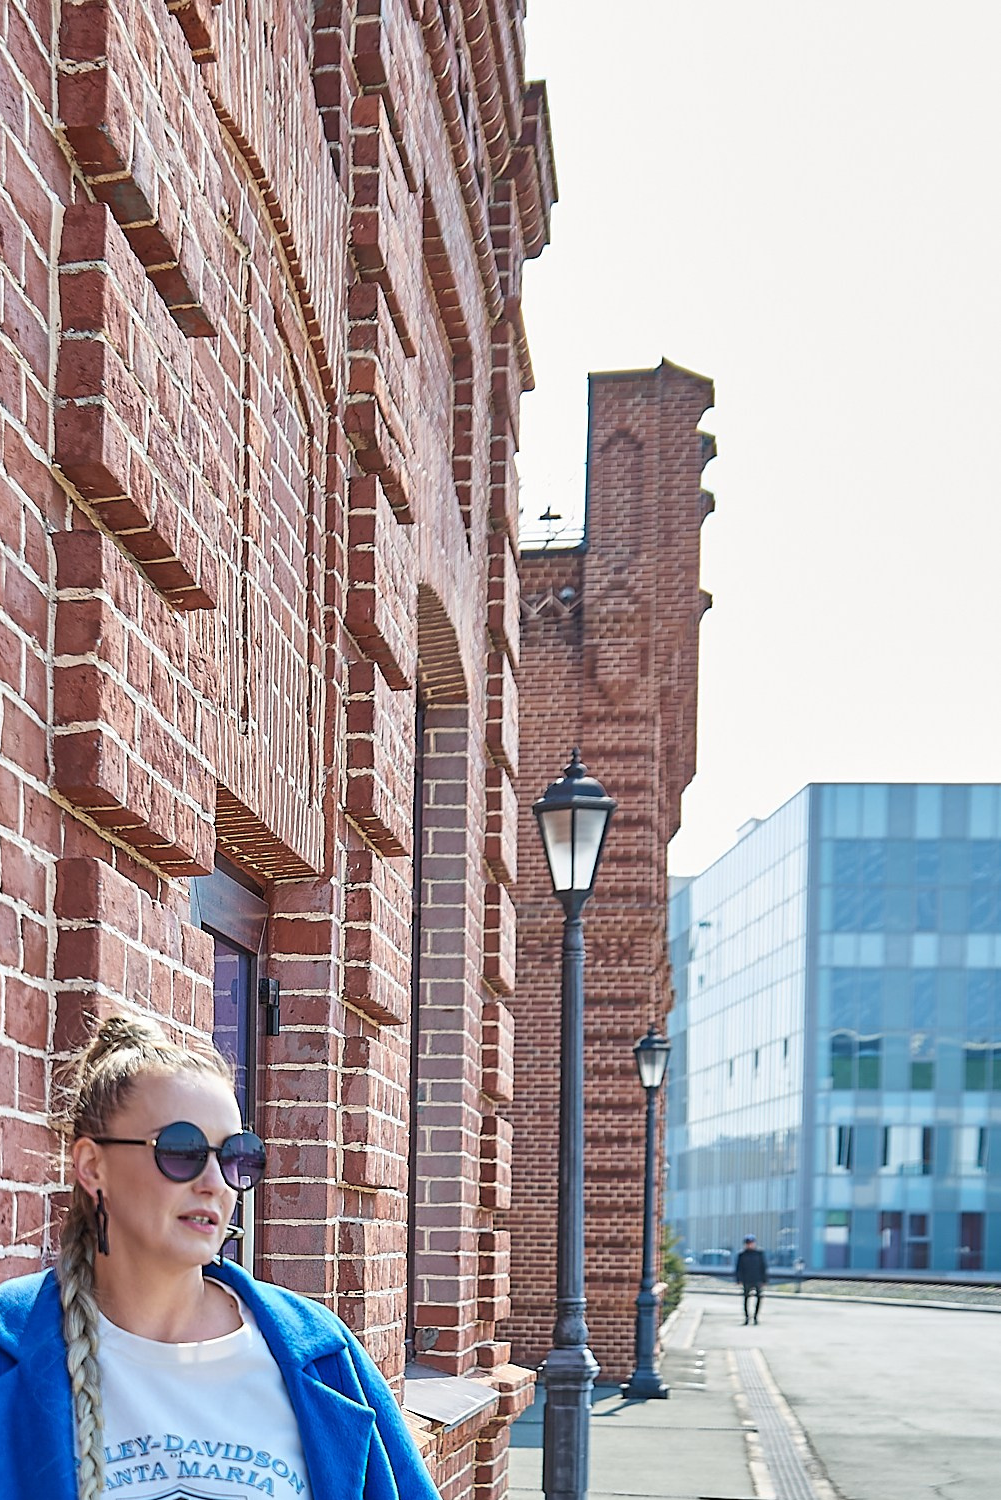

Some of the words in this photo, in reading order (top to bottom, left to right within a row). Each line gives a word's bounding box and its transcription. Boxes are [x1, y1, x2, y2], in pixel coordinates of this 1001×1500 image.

[104, 1434, 305, 1495] LEY-DAVIDSON
[104, 1462, 169, 1490] ANTA
[177, 1460, 275, 1497] MARIA
